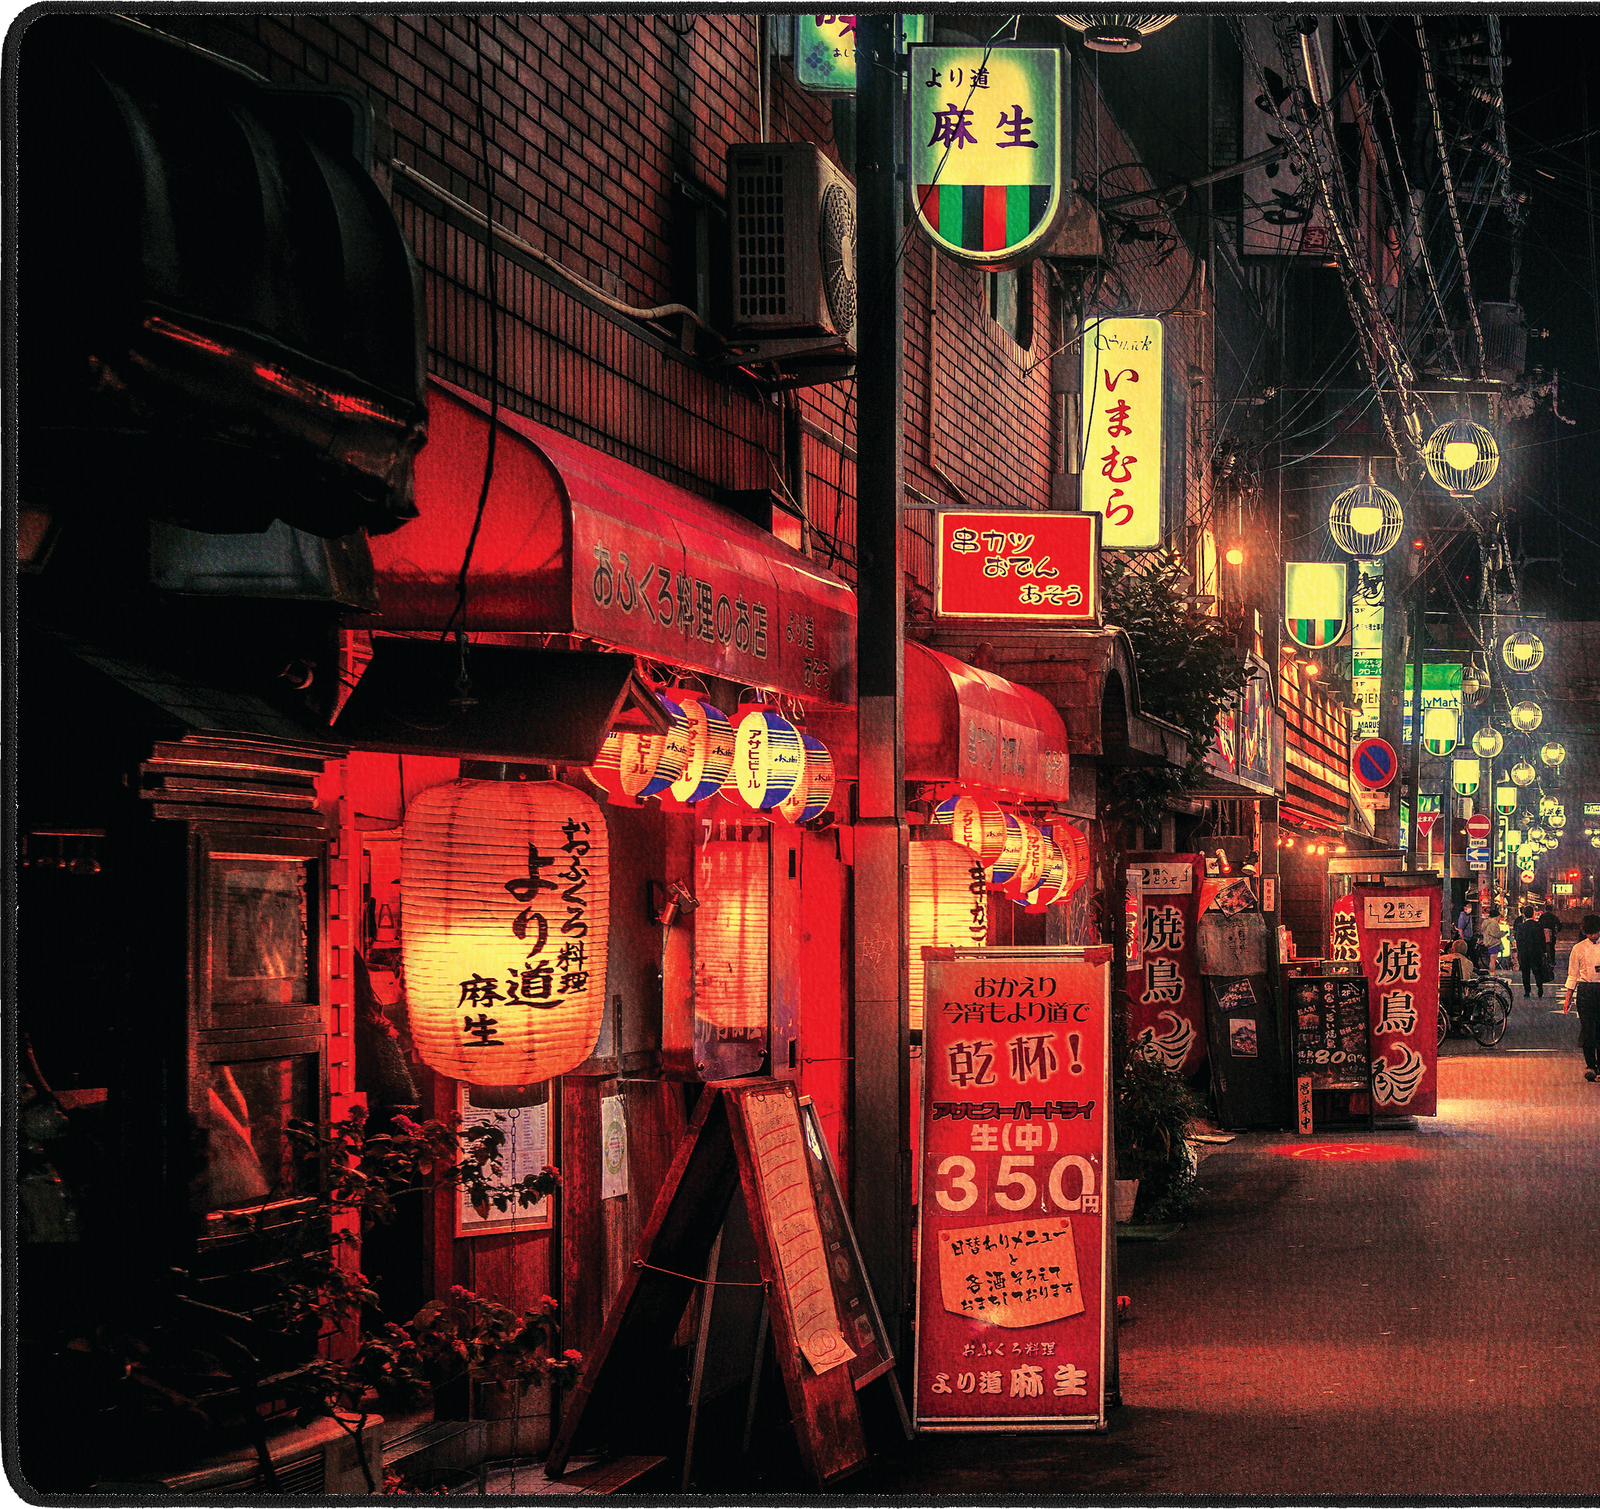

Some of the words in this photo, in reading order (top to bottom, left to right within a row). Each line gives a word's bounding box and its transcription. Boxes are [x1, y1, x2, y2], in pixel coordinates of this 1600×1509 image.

[925, 68, 991, 89] より道
[928, 104, 1039, 150] 麻生
[1101, 368, 1140, 526] いまむら
[951, 527, 1035, 554] 串カツ
[983, 555, 1059, 579] おでん
[592, 538, 770, 661] おふくろ料理のお店
[1019, 584, 1083, 606] あそう
[667, 742, 687, 754] Asahi
[712, 746, 733, 756] Asahi
[748, 729, 761, 789] アサヒビール
[774, 754, 797, 764] Asahi
[1153, 876, 1178, 885] どうぞ
[556, 817, 597, 993] おふくろ料理
[1383, 902, 1395, 918] 2
[1398, 910, 1423, 918] どうぞ
[505, 843, 563, 1008] より道
[1142, 906, 1186, 1003] 焼鳥
[973, 976, 1057, 998] おかえり
[1375, 939, 1422, 1036] 焼鳥
[458, 972, 503, 1047] 麻生
[942, 1003, 1090, 1024] 今宵もより道で
[948, 1035, 1083, 1089] 乾杯!
[932, 1101, 1095, 1121] アサヒスーパードライ
[970, 1122, 1058, 1151] 生(中)
[952, 1229, 1067, 1256] 日替わりメニュー
[1008, 1254, 1018, 1266] と
[961, 1283, 1073, 1311] おまちしております
[961, 1341, 1057, 1358] おふくろ料理
